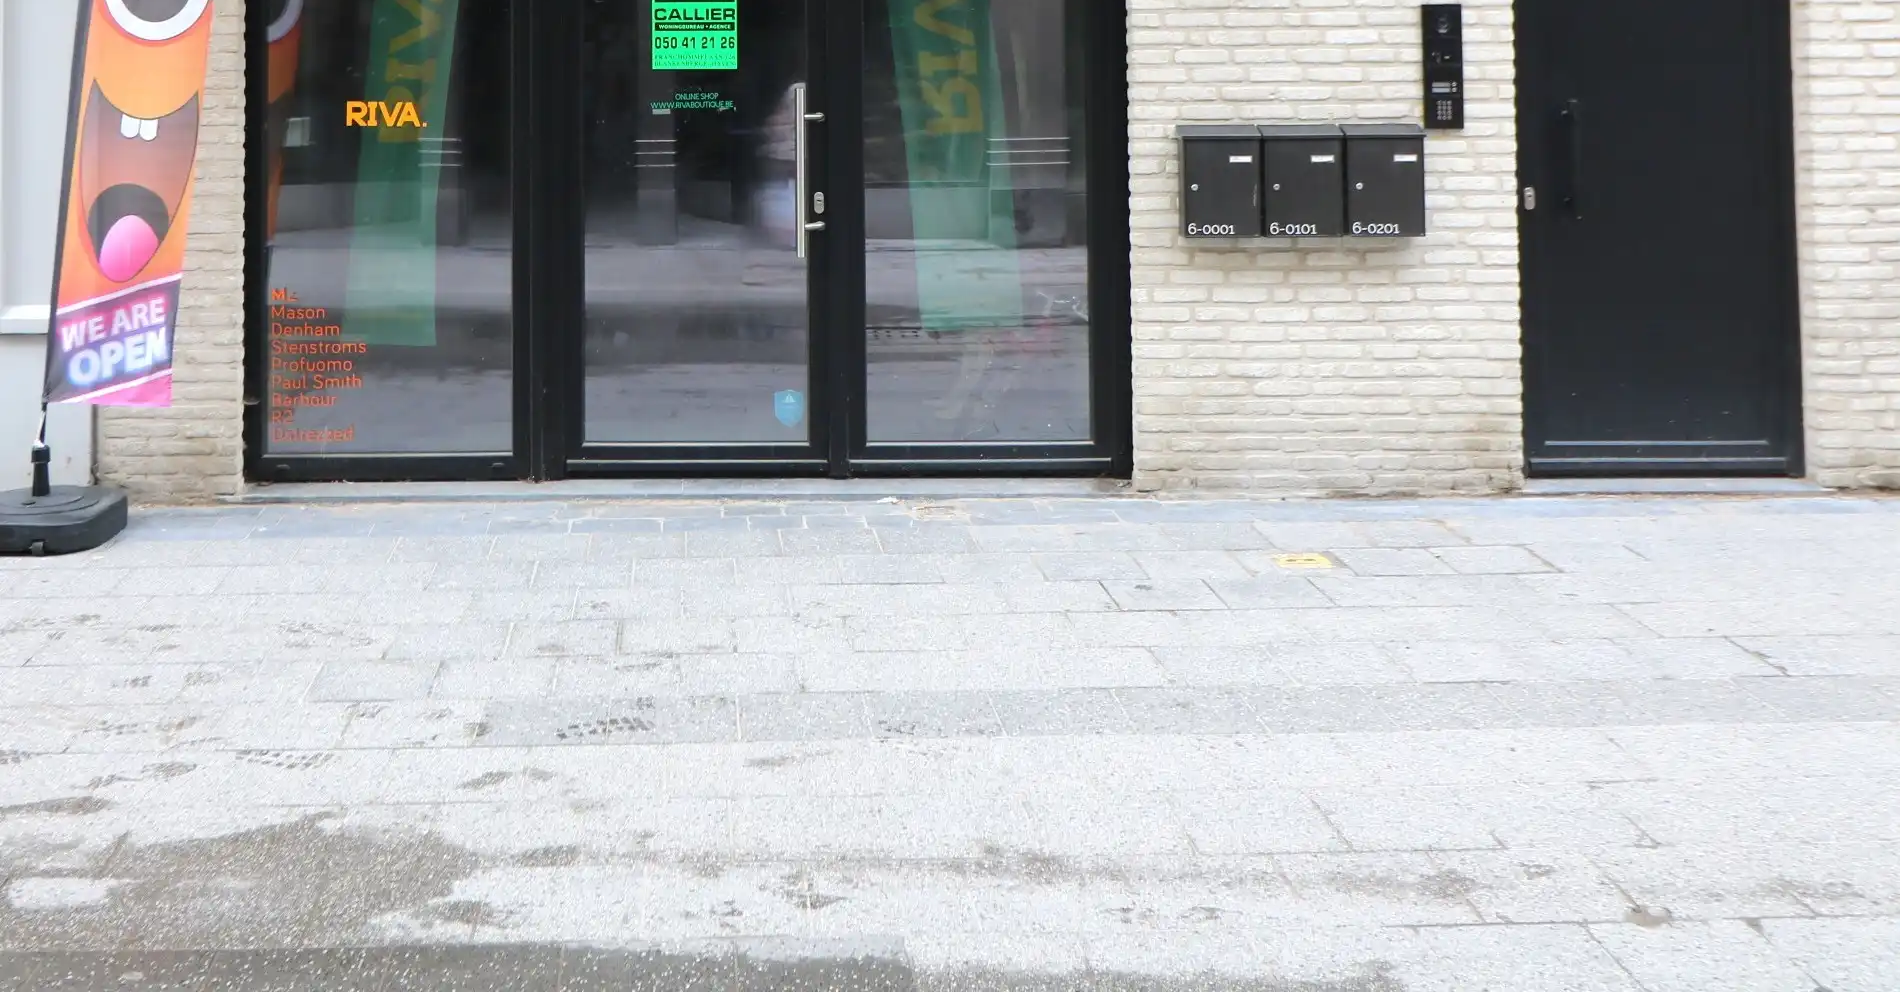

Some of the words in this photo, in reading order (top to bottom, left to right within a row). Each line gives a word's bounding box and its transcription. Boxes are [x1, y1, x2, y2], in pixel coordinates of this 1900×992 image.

[654, 8, 736, 21] CALLIER
[654, 36, 678, 49] 050
[681, 36, 696, 49] 41
[701, 36, 715, 49] 21
[720, 36, 735, 49] 26
[650, 101, 734, 109] WWW.RIVABOUTIQUE.BE
[345, 101, 427, 127] RIVA.
[1187, 222, 1236, 236] 6-0001
[1270, 222, 1317, 235] 6-0101
[1352, 221, 1400, 235] 6-0201
[271, 306, 326, 319] Mason
[61, 315, 107, 353] WE
[110, 296, 166, 336] ARE
[271, 322, 341, 337] Denham
[271, 339, 367, 355] Stenstroms
[67, 326, 169, 386] OPEN
[271, 357, 353, 372] Profuomo
[271, 374, 308, 389] Paul
[312, 374, 362, 390] Smith
